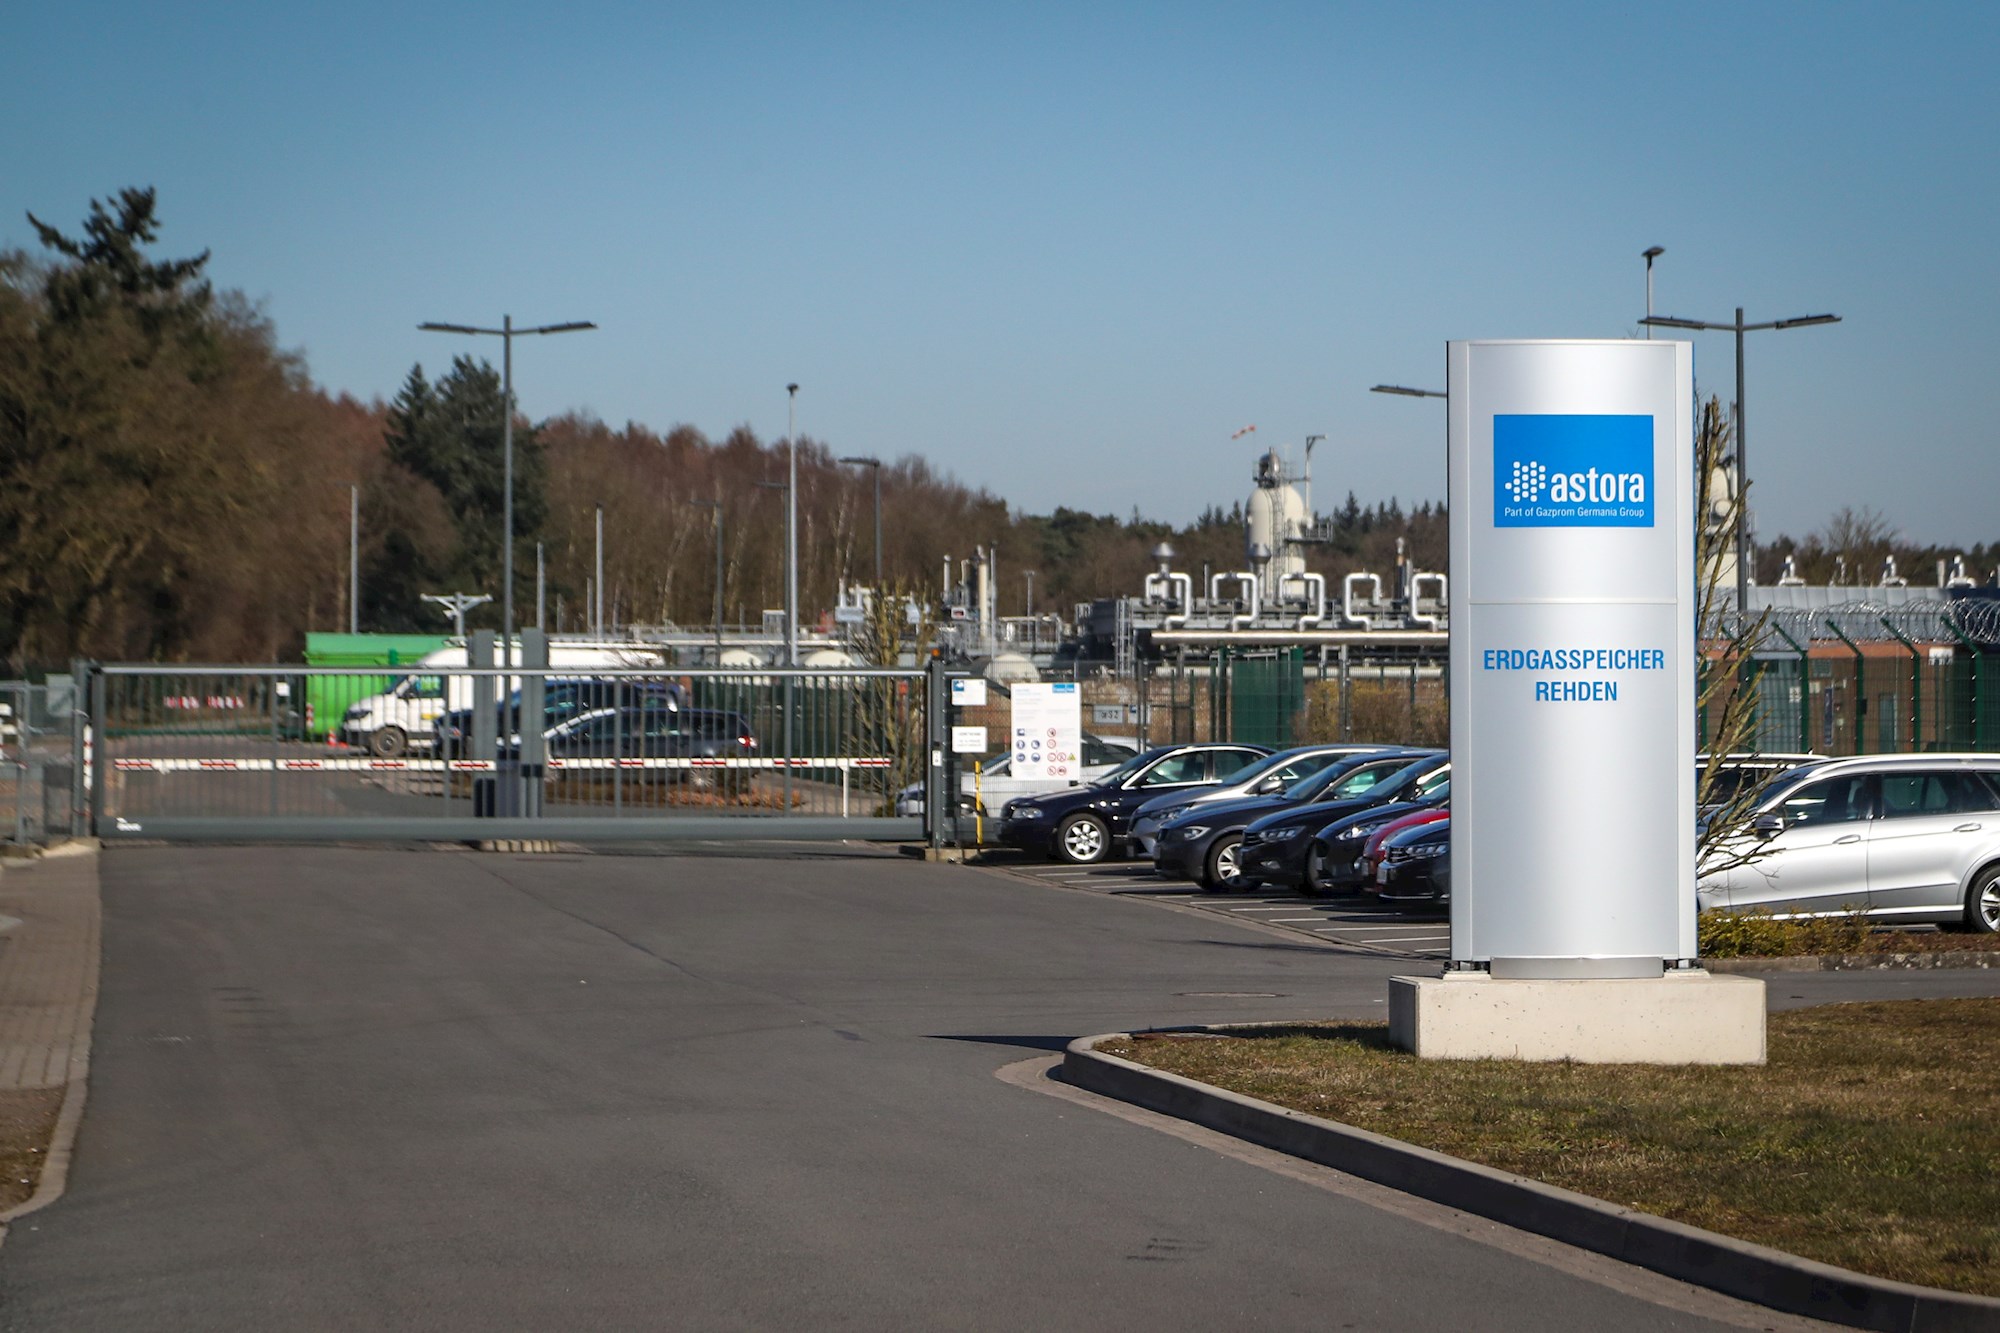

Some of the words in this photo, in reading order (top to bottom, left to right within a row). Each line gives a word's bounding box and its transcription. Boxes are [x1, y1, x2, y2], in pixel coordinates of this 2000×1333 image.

[1550, 467, 1645, 503] astora
[1504, 507, 1523, 517] Part
[1525, 507, 1534, 517] of
[1536, 507, 1575, 519] Gazprom
[1577, 507, 1618, 517] Germania
[1619, 507, 1645, 519] Group
[1484, 649, 1664, 670] ERDGASSPEICHER
[1535, 681, 1617, 702] REHDEN
